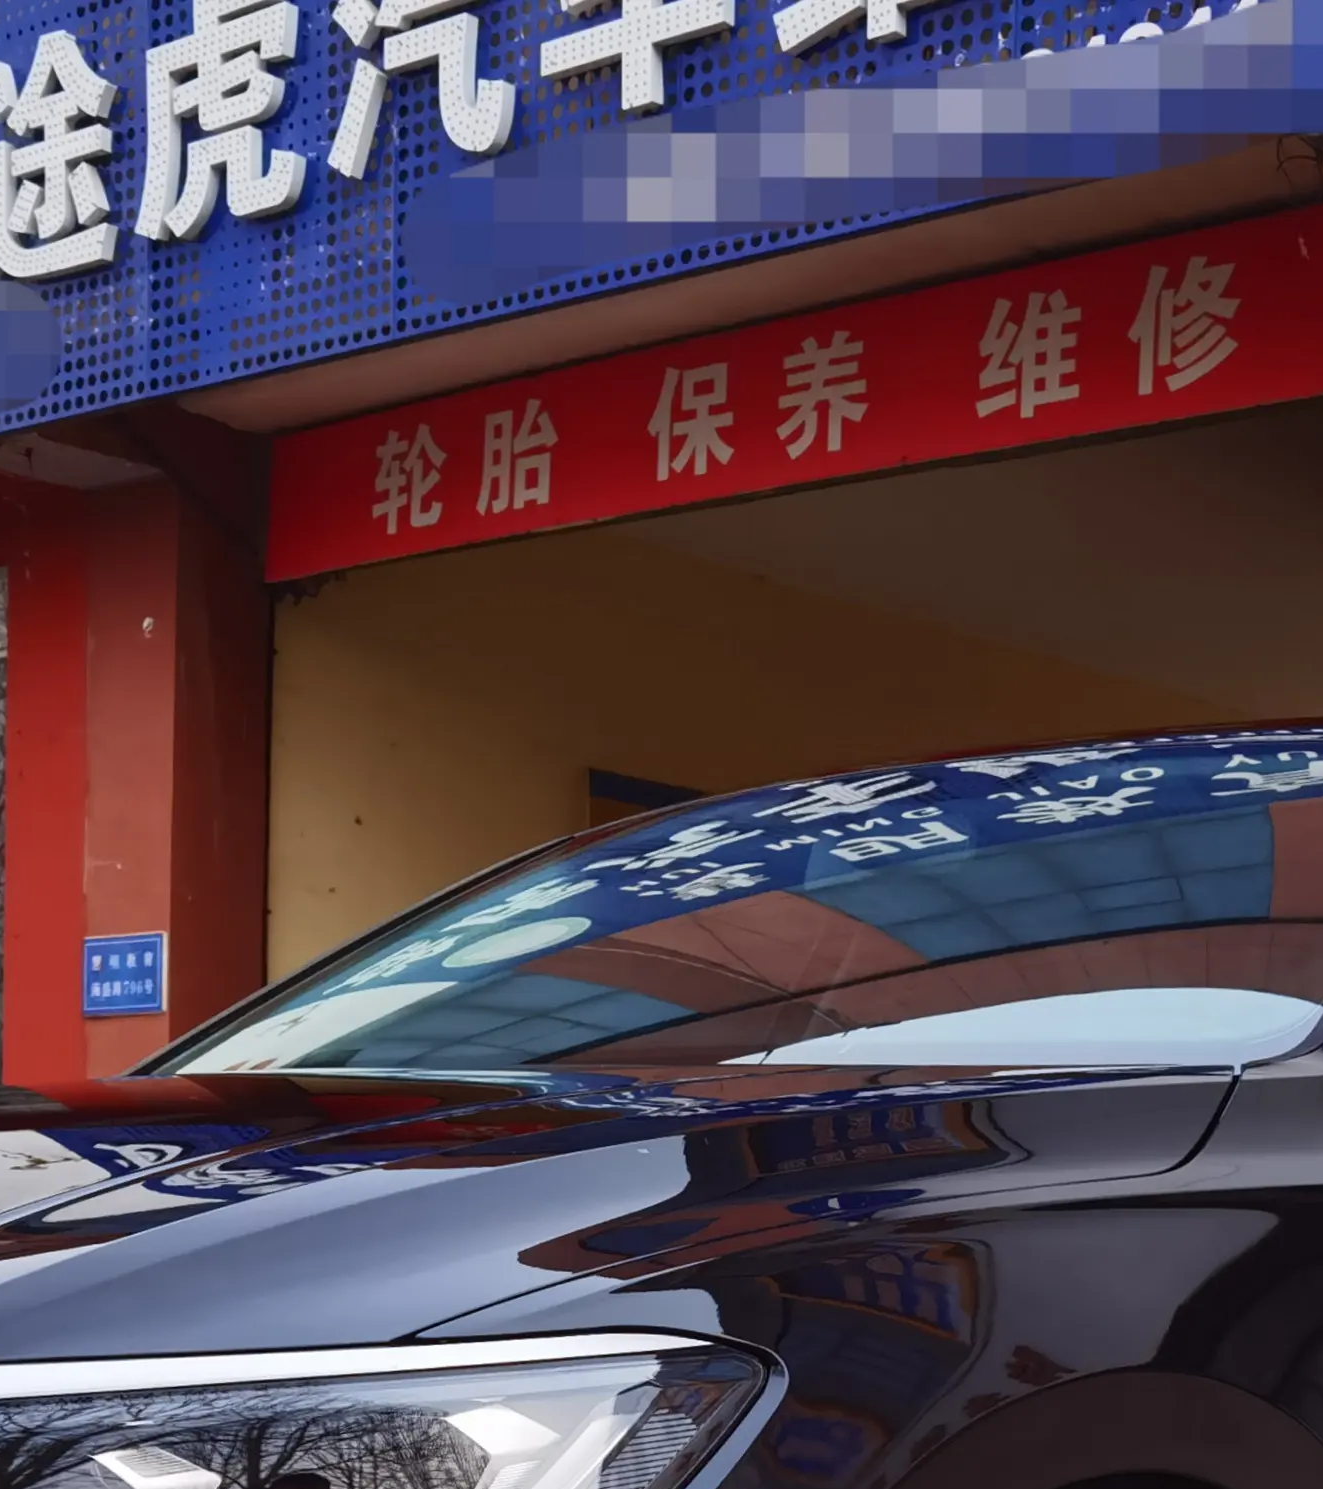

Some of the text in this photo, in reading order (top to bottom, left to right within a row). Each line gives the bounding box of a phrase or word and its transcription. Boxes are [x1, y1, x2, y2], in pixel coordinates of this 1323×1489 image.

[370, 254, 1243, 536] 轮胎 保养 维修
